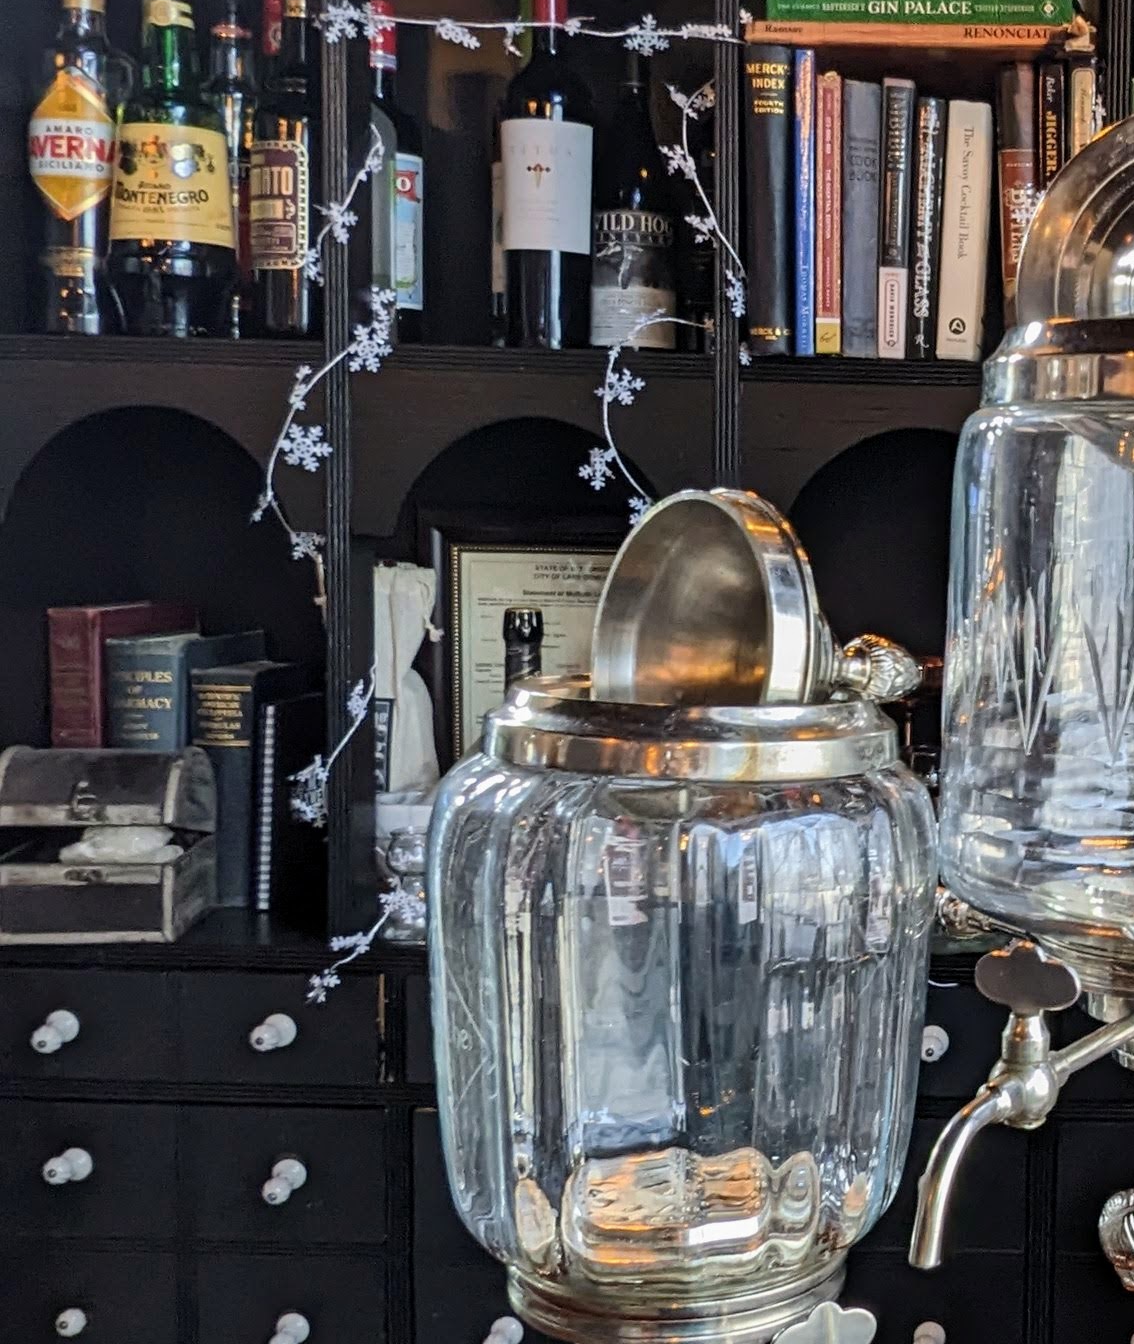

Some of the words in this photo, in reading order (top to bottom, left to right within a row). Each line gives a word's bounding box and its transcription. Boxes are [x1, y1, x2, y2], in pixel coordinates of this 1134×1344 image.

[868, 0, 899, 16] GIN
[904, 0, 972, 16] PALACE
[752, 77, 785, 91] INDEX
[1045, 76, 1055, 104] Baker
[754, 106, 785, 116] EDITION
[46, 124, 93, 135] AMARO
[887, 92, 907, 171] IMBIBE!
[962, 127, 974, 148] The
[38, 157, 104, 172] SICILIANO
[957, 150, 974, 182] Savoy
[957, 185, 972, 229] Cocktail
[956, 232, 969, 260] Book
[913, 260, 931, 318] GLASS
